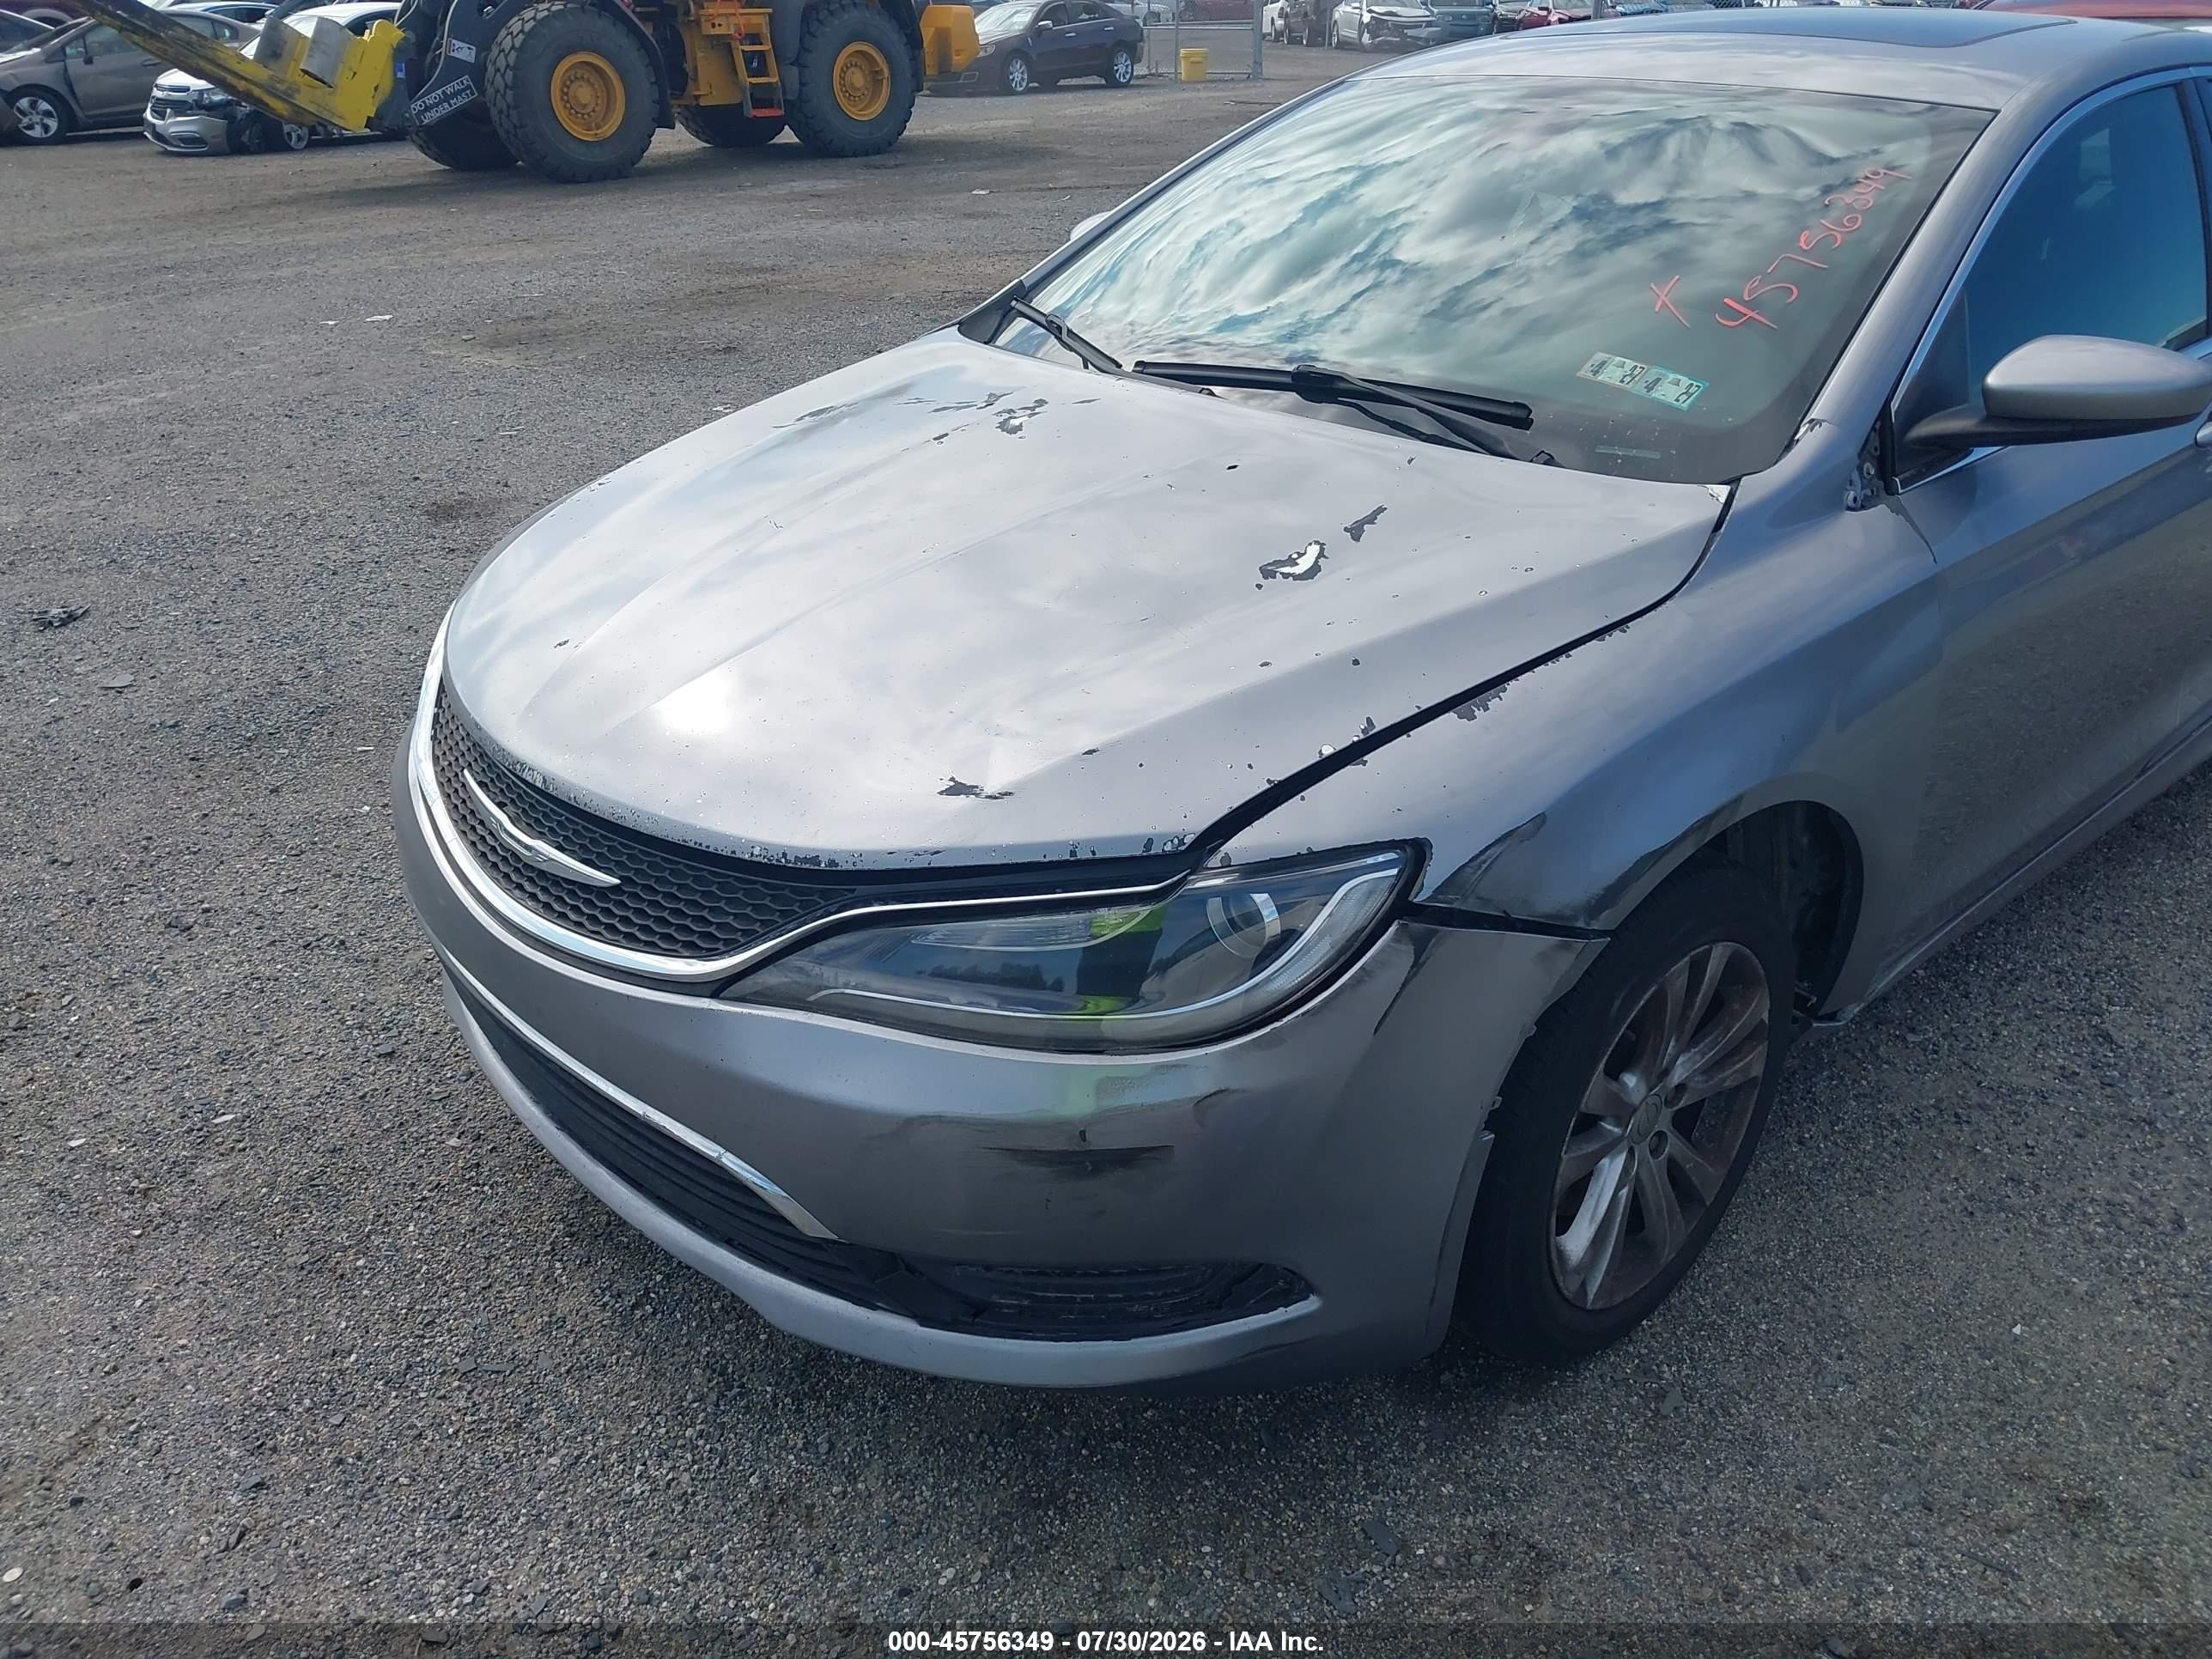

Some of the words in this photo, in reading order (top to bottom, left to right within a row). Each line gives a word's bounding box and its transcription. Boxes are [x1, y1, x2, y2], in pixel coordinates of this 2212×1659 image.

[412, 102, 424, 113] DO
[426, 90, 445, 106] NOT
[445, 78, 471, 95] WALK
[421, 102, 448, 121] UNDER
[450, 89, 471, 106] MAST
[1715, 167, 1912, 330] 45756349
[1619, 364, 1645, 385] 27
